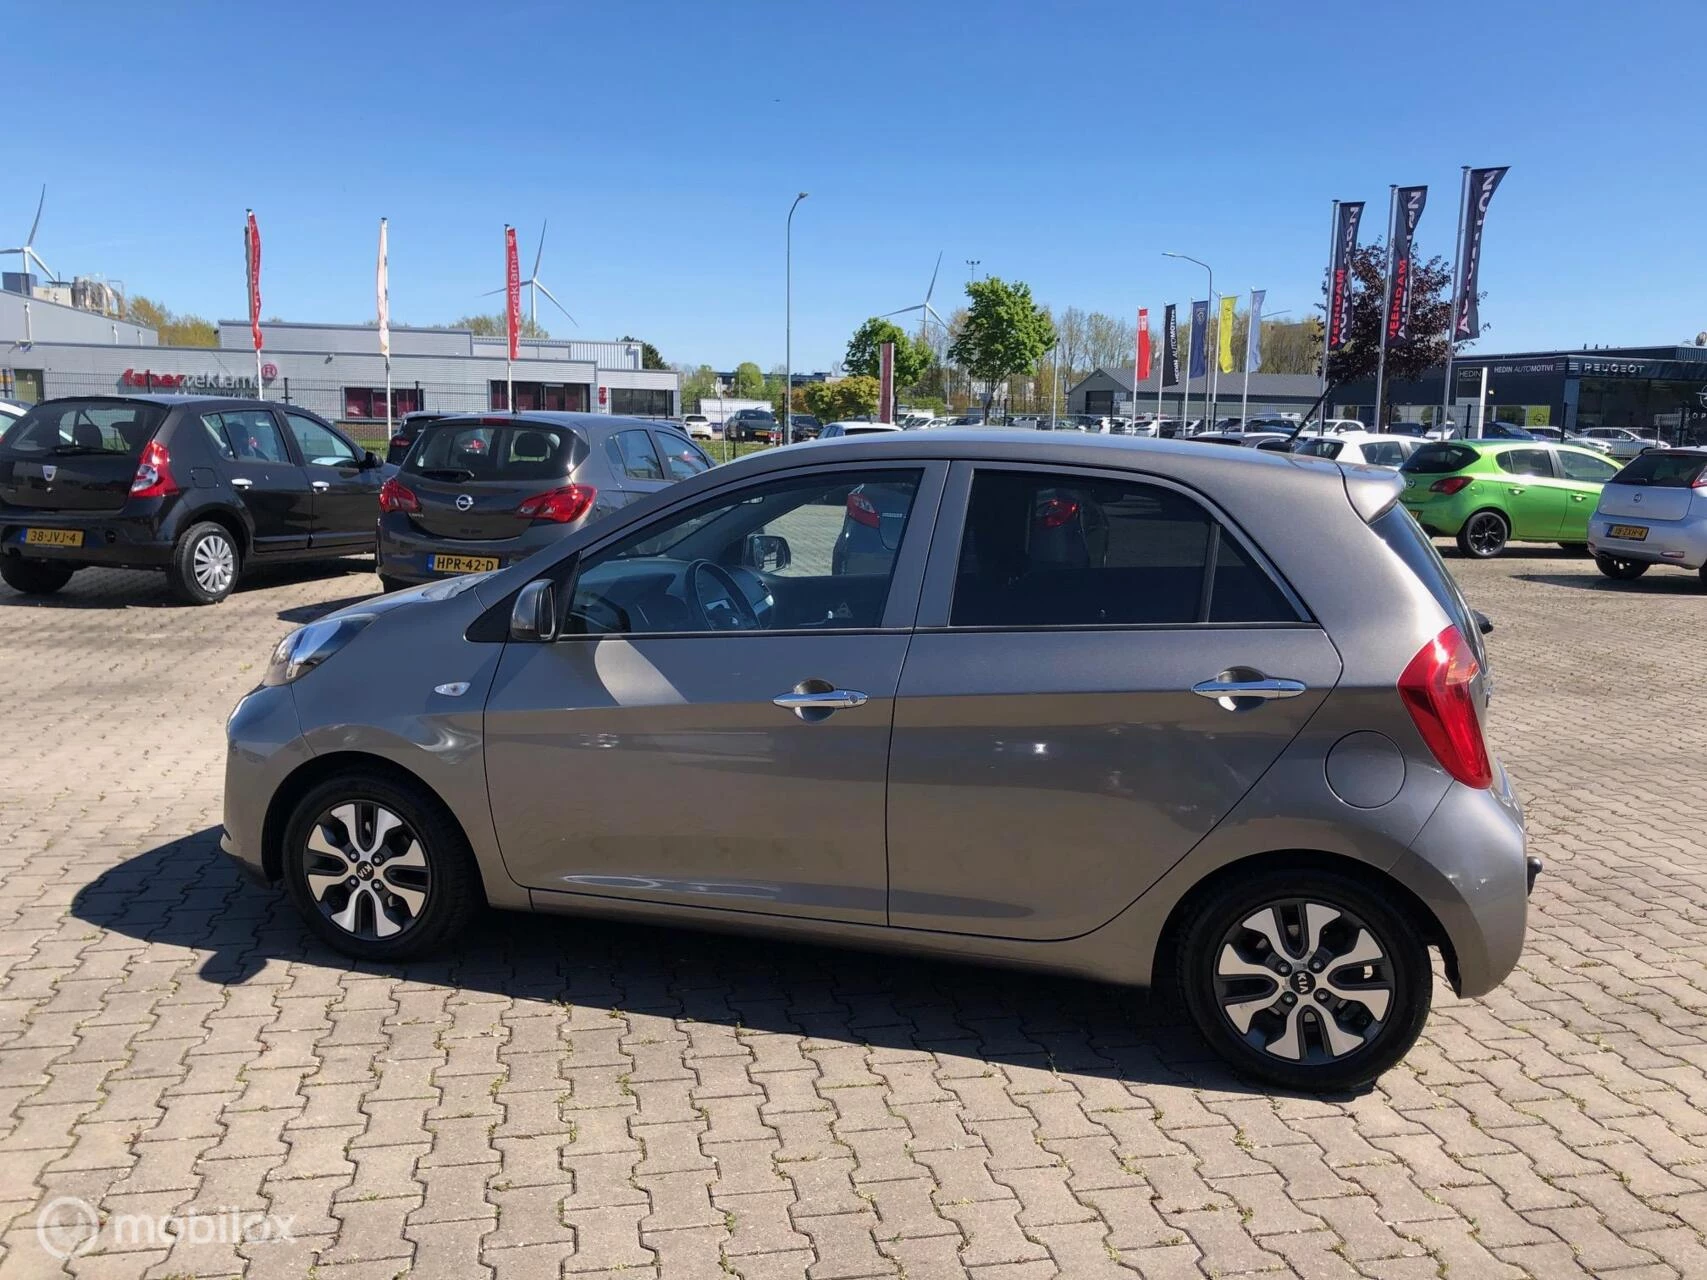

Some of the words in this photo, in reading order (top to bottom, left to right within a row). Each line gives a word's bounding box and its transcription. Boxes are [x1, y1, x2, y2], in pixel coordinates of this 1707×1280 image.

[1389, 259, 1408, 339] VEENDAM
[1331, 269, 1345, 345] VEENDAM
[1460, 370, 1481, 378] HEDIN
[1494, 365, 1513, 373] HEDIN
[1584, 362, 1645, 373] PEUGEOT
[30, 530, 76, 543] 38-JVJ-4
[436, 557, 495, 571] HPR-42-D
[357, 864, 373, 878] KIA
[1297, 973, 1309, 993] KIA
